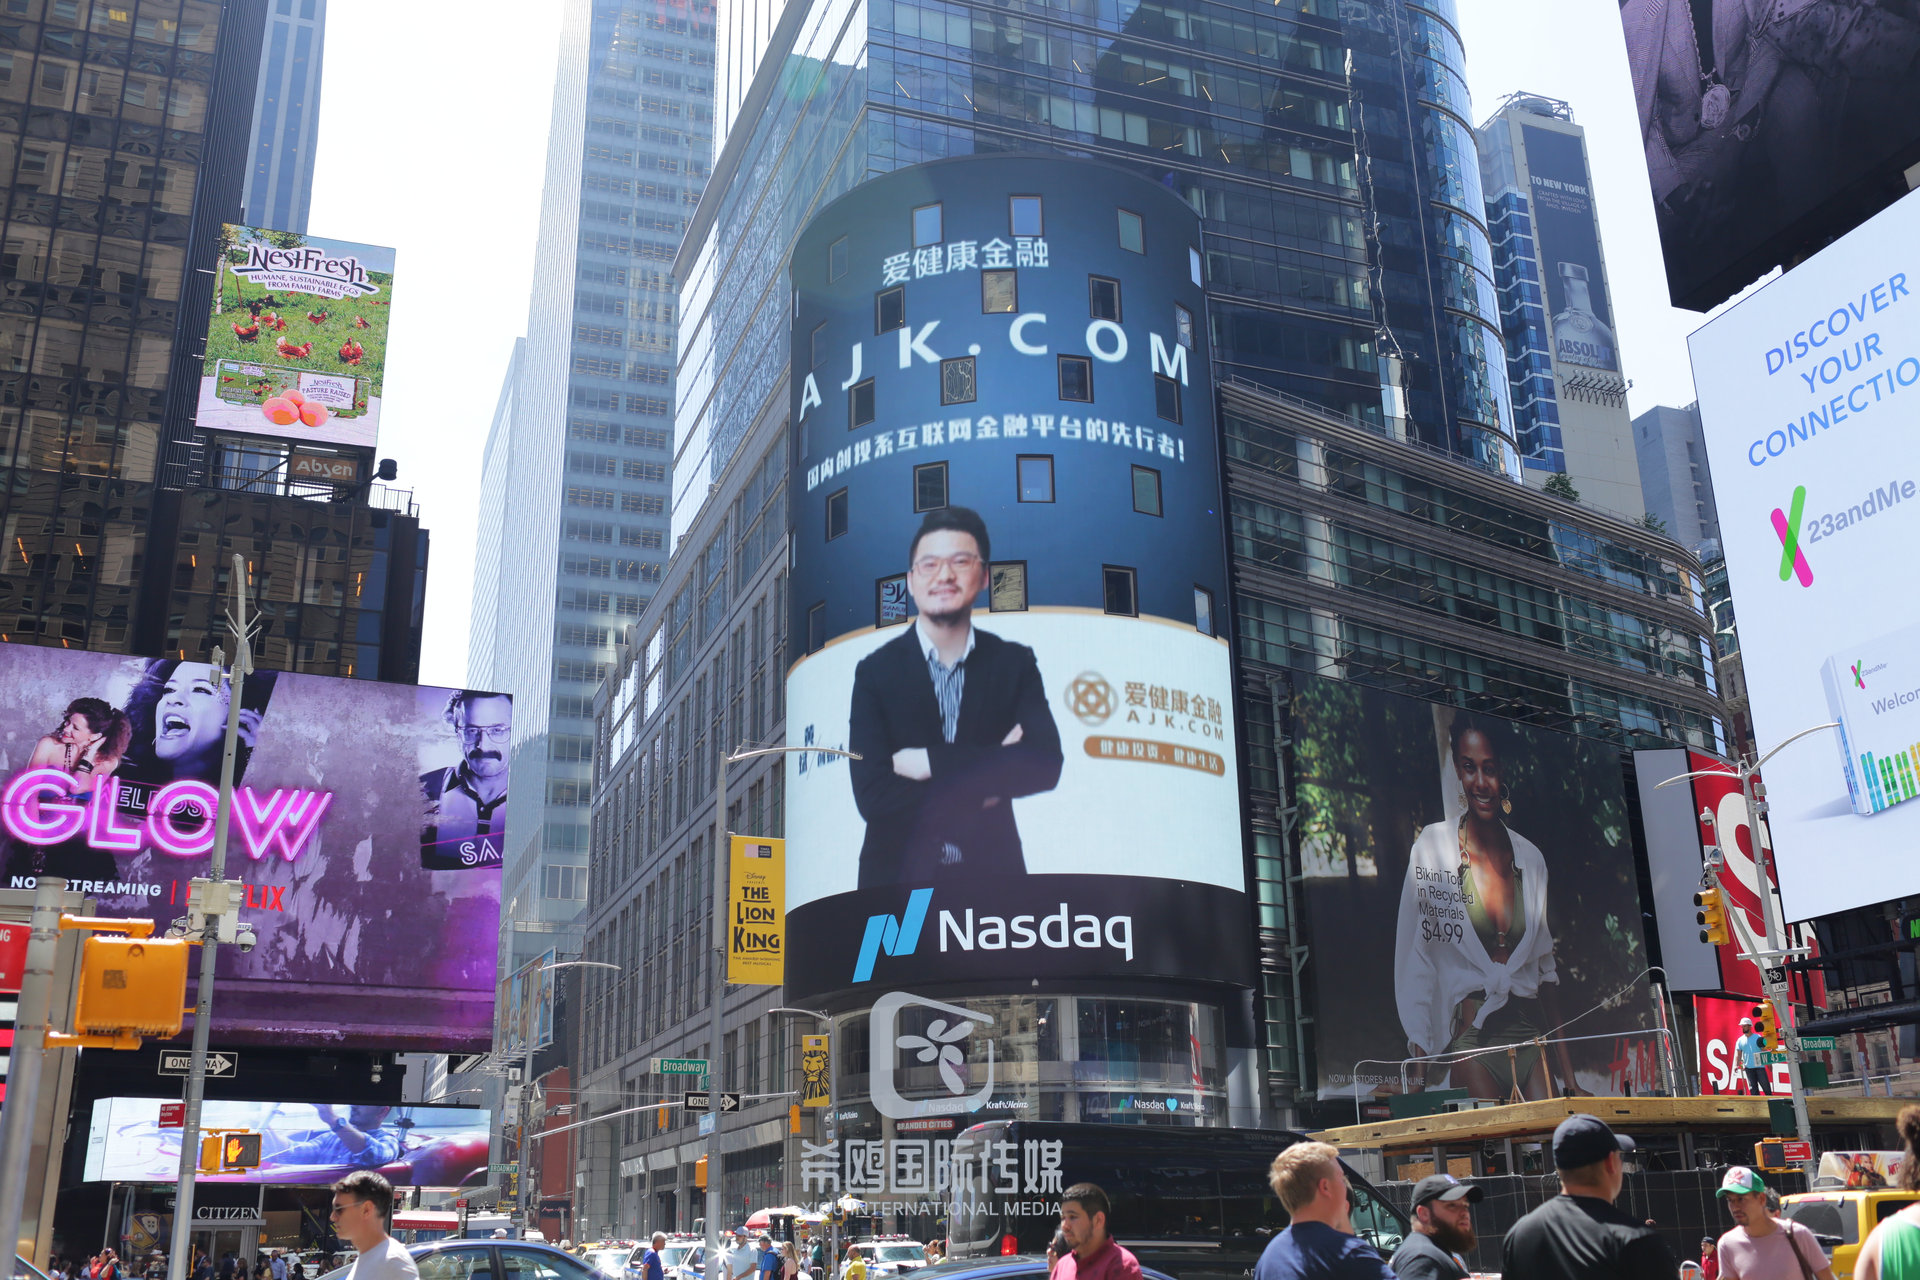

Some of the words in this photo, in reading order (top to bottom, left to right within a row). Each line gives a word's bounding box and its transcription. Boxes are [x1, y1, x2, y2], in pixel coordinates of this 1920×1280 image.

[1531, 175, 1542, 185] TO
[1543, 178, 1562, 190] NEW
[251, 245, 364, 282] NestFresh
[882, 236, 1050, 287] 爱健康金融
[251, 274, 288, 282] HUMANE,
[289, 275, 338, 289] SUSTAINABLE
[339, 284, 359, 296] EGGS
[268, 281, 290, 289] FROM
[291, 283, 316, 293] FAMILY
[317, 287, 342, 298] FARMS
[1765, 272, 1910, 376] DISCOVER
[1800, 332, 1884, 394] YOUR
[1748, 357, 1920, 467] CONNECTIO
[296, 459, 353, 477] Absen
[1124, 681, 1223, 726] 爱健康金融
[2, 768, 333, 861] GLOW
[11, 875, 37, 889] NO
[64, 879, 162, 897] STREAMING
[1415, 866, 1443, 883] Bikini
[1444, 870, 1464, 889] Top
[742, 886, 769, 899] THE
[1416, 884, 1427, 898] in
[1428, 885, 1474, 906] Recycled
[1419, 901, 1465, 920] Materials
[733, 926, 780, 953] KING
[939, 902, 1134, 962] Nasdaq
[1421, 918, 1464, 944] $4.99
[1803, 1038, 1834, 1050] Broadway
[171, 1058, 190, 1068] ONE
[663, 1061, 706, 1074] Broadway
[1608, 1038, 1656, 1095] H&M
[1328, 1074, 1346, 1083] NOW
[1356, 1074, 1385, 1084] STORES
[1385, 1076, 1399, 1085] AND
[1401, 1077, 1425, 1086] NLINE
[693, 1098, 708, 1106] ONE
[721, 1099, 732, 1108] AY
[928, 1103, 964, 1114] Nasdaq
[1134, 1100, 1165, 1112] Nasdaq
[896, 1122, 927, 1131] BRANDED
[928, 1120, 953, 1129] CITIES
[490, 1164, 517, 1173] BROADWAY
[196, 1206, 260, 1220] CITIZEN
